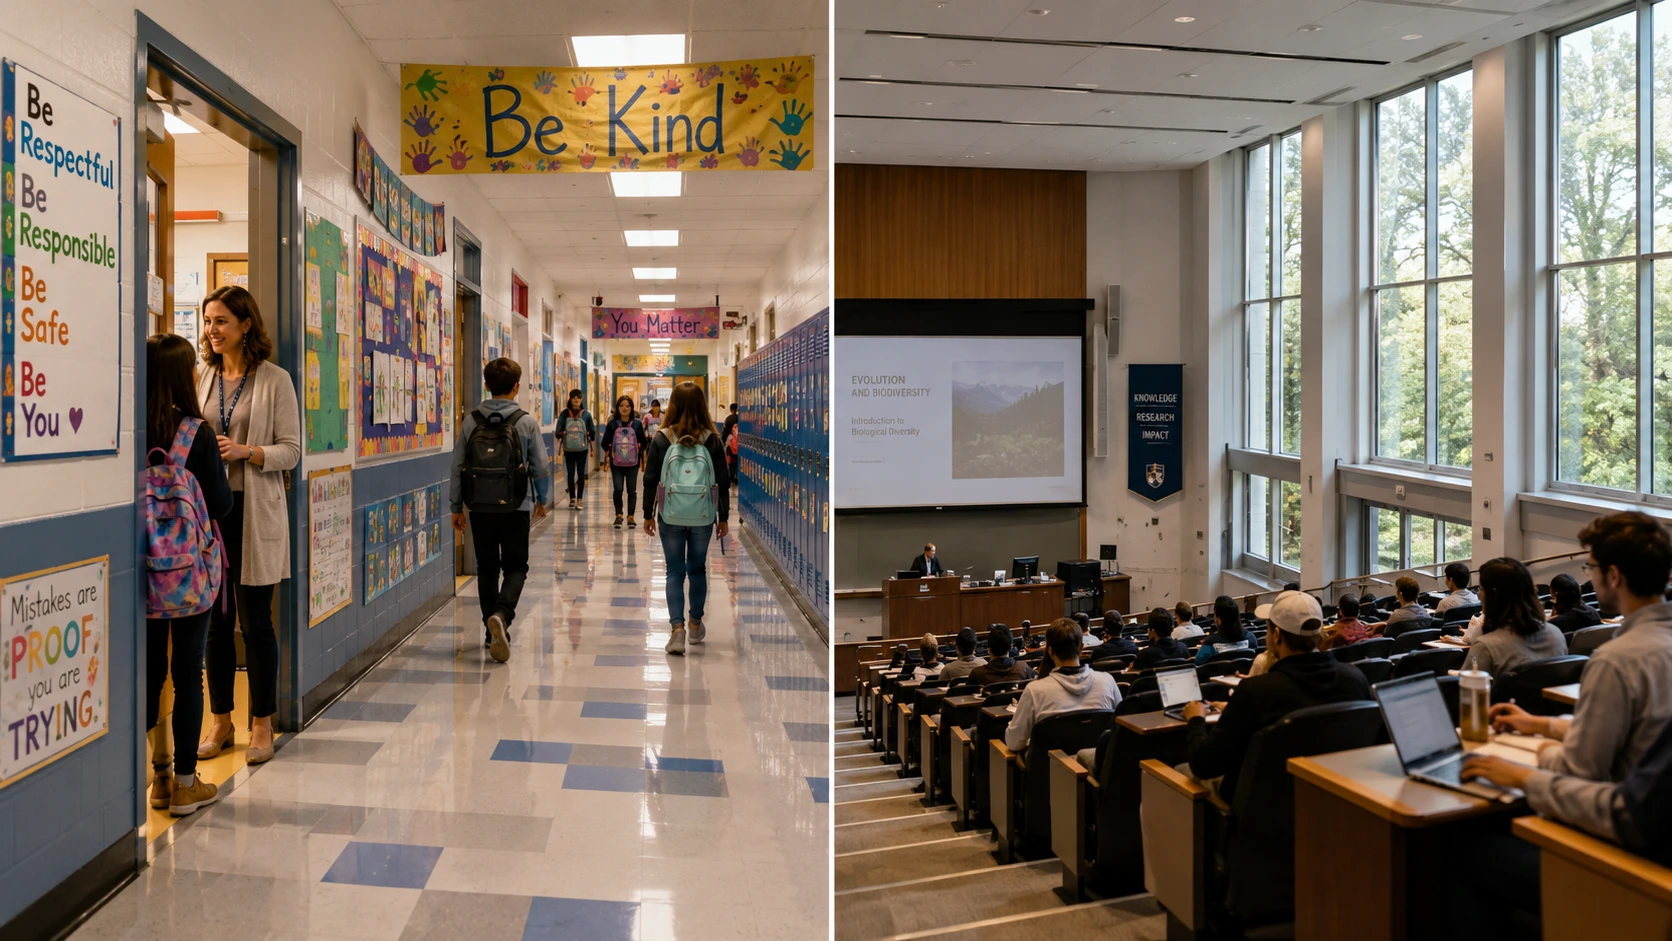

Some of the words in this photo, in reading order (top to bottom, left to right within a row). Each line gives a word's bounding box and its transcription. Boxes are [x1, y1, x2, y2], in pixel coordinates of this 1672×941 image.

[27, 82, 54, 126] Be
[483, 84, 568, 158] Be
[608, 83, 725, 157] Kind
[20, 120, 114, 190] Respectful
[21, 173, 47, 213] Be
[19, 212, 116, 269] Responsible
[21, 266, 47, 302] Be
[21, 308, 70, 346] Safe
[611, 312, 638, 334] You
[647, 314, 700, 334] Matter
[21, 360, 47, 397] Be
[852, 375, 906, 384] EVOLUTION
[852, 388, 870, 397] AND
[873, 388, 931, 397] BIODIVERSITY
[1133, 393, 1178, 403] KNOWLEDGE
[21, 403, 60, 438] You
[852, 417, 895, 425] Introduction
[897, 417, 905, 425] to
[852, 428, 887, 438] Biological
[889, 428, 920, 437] Diversity
[1136, 412, 1175, 422] RESEARCH
[1142, 430, 1170, 440] IMPACT
[10, 585, 72, 627] Mistakes
[77, 584, 98, 607] are
[11, 613, 94, 680] PROOF
[28, 677, 54, 711] you
[58, 667, 81, 690] are
